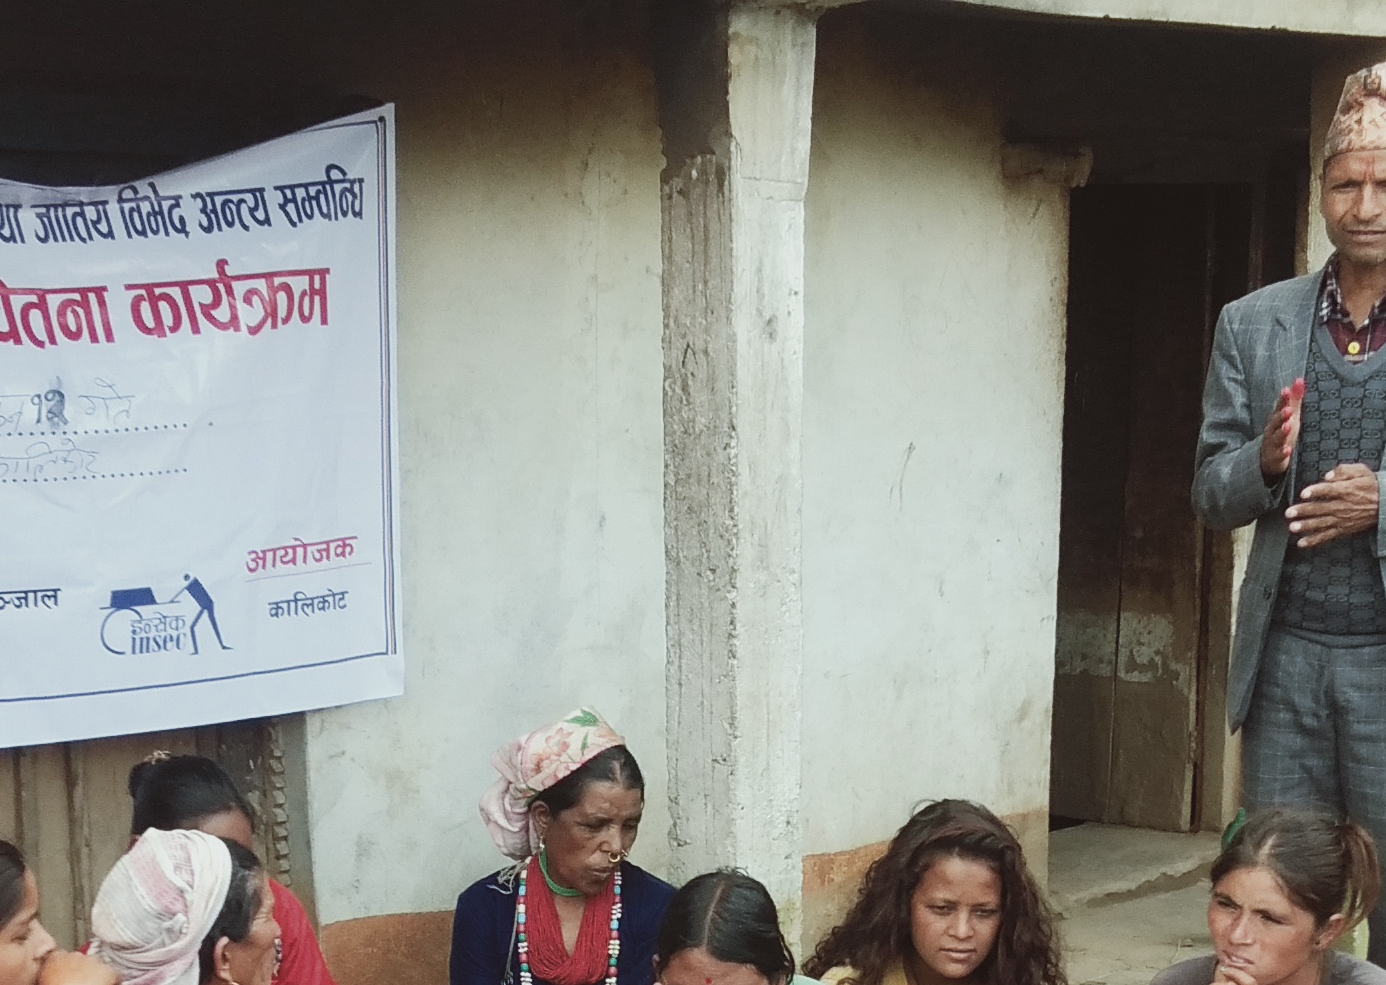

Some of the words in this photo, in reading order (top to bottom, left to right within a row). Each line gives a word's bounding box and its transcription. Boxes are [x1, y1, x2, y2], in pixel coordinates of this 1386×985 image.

[117, 182, 190, 239] विभेद
[190, 187, 272, 234] अन्त्य
[124, 259, 330, 339] कार्यक्रम
[245, 536, 359, 574] आयोजक
[268, 588, 350, 620] कालिकोट
